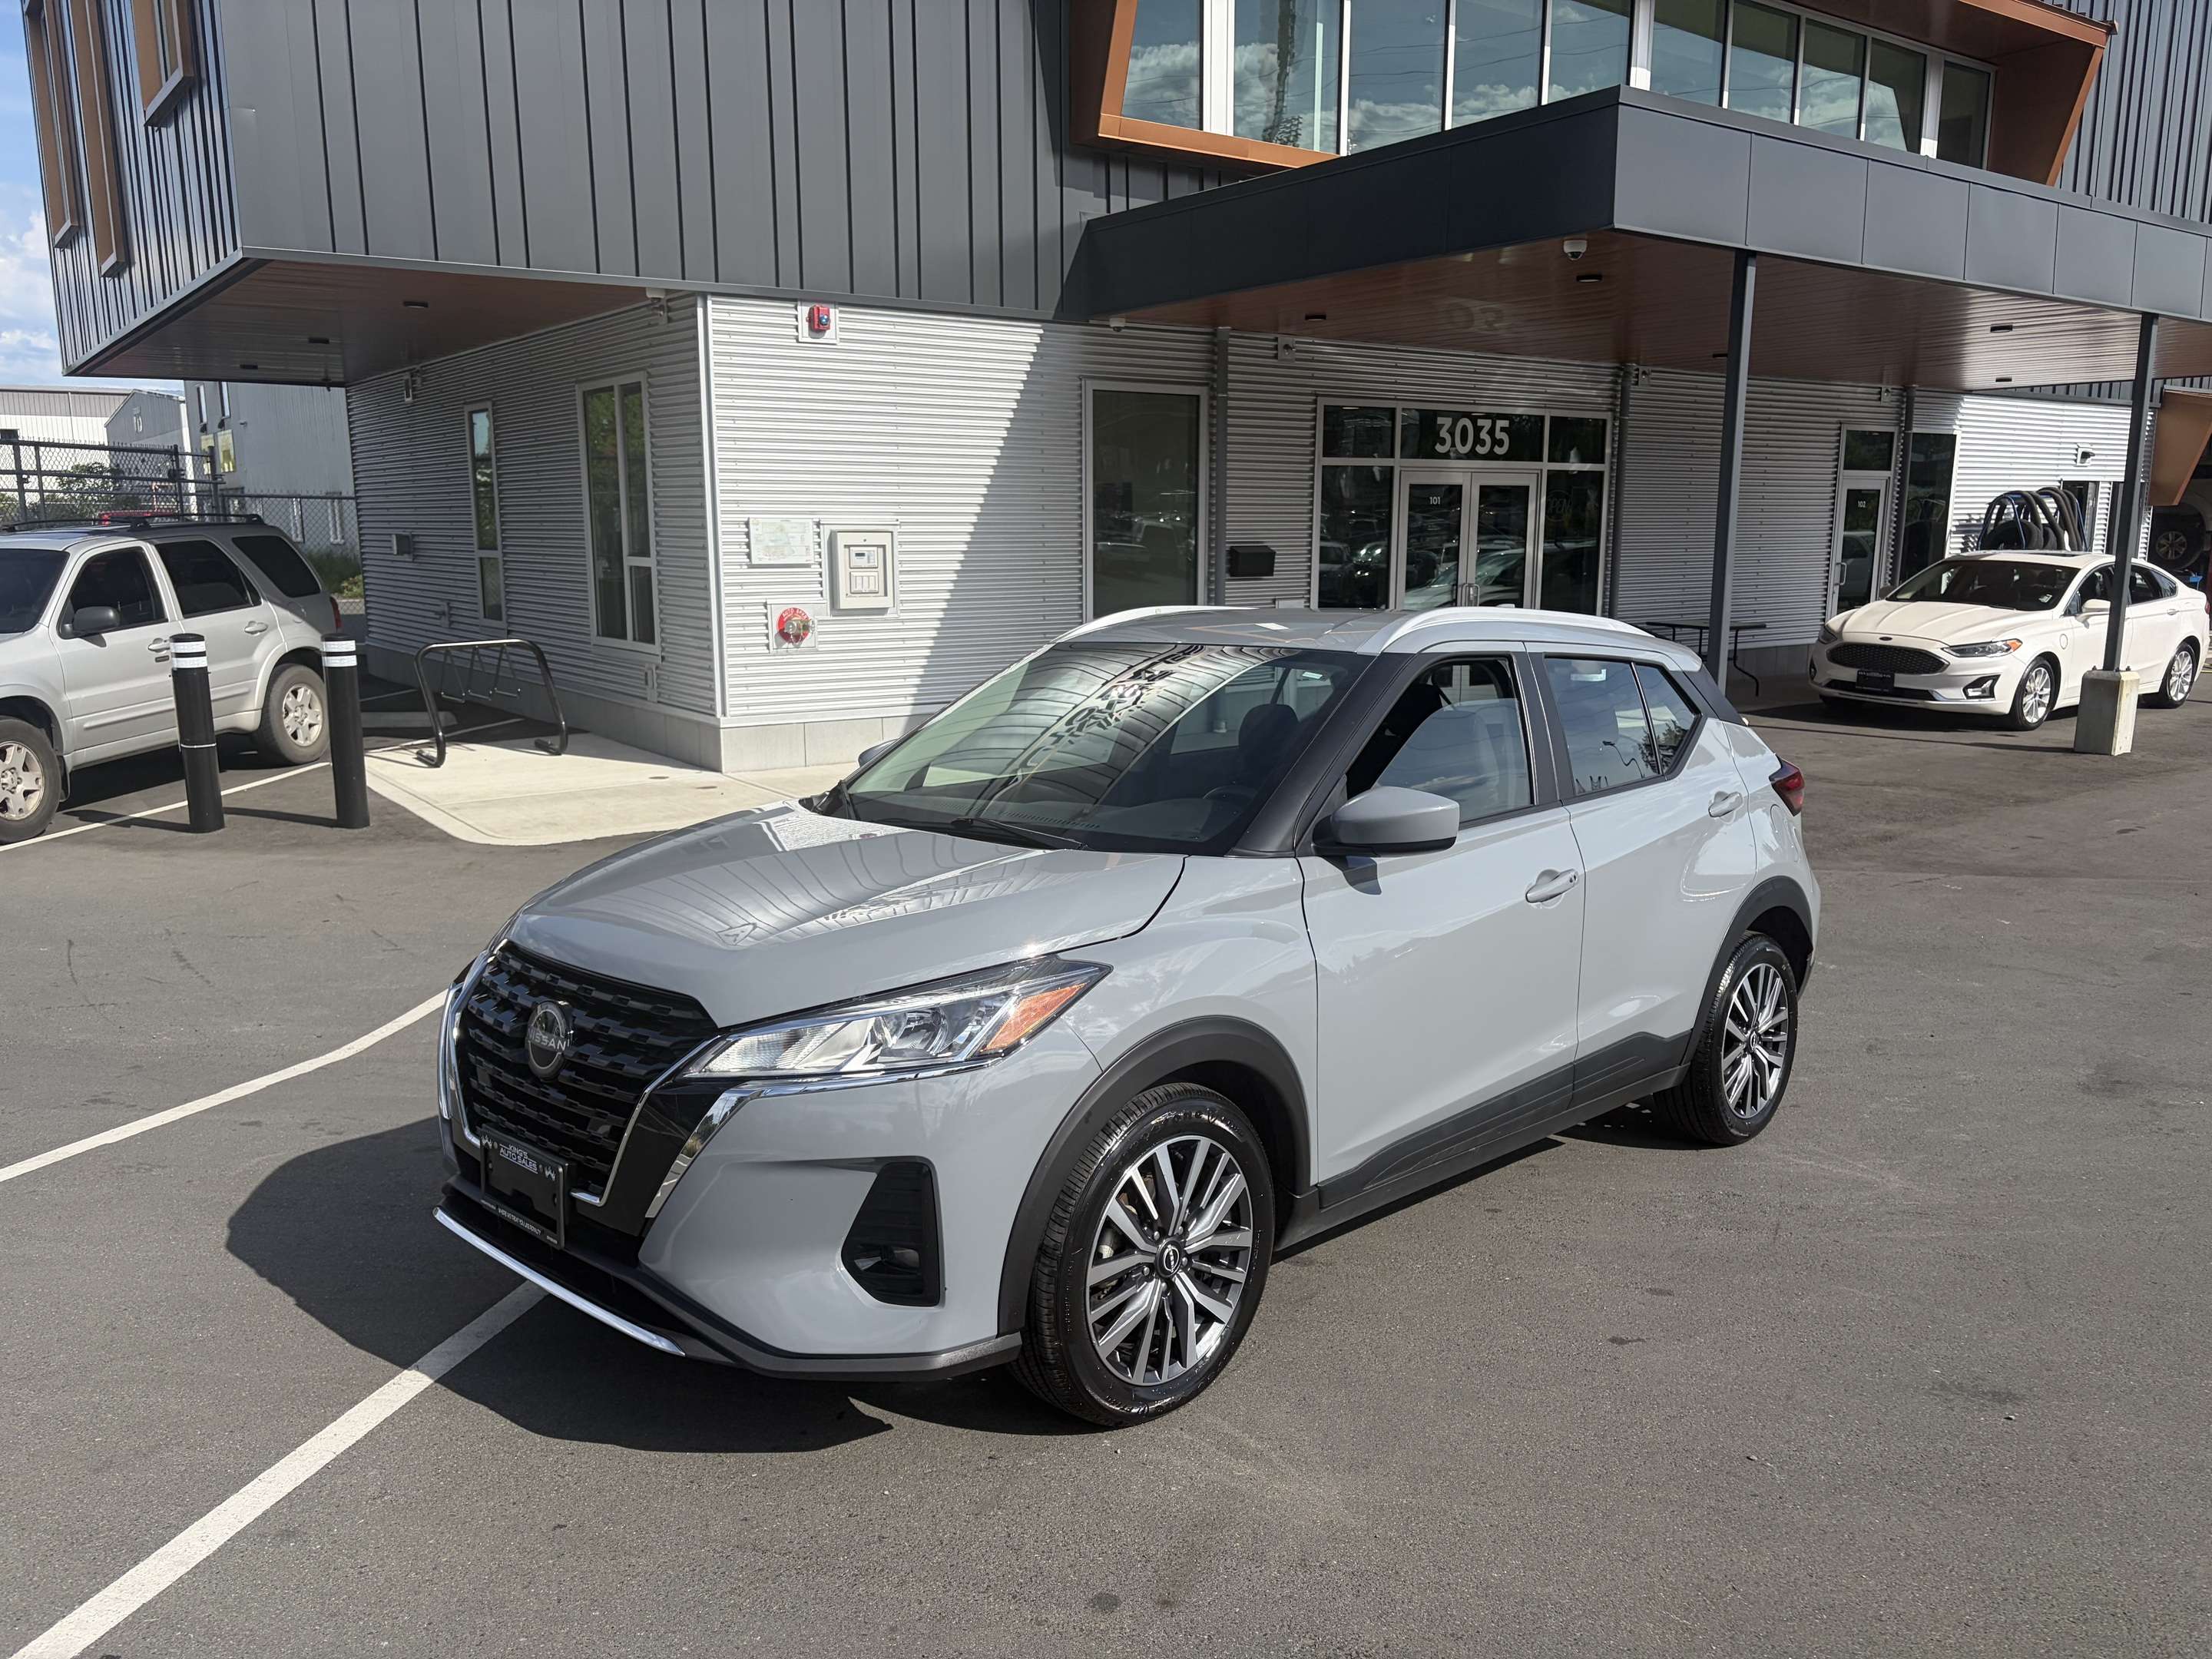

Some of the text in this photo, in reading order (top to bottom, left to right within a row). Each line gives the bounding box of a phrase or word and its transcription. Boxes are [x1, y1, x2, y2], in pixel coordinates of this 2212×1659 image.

[1435, 416, 1510, 455] 3035
[1429, 496, 1441, 505] 101
[528, 1028, 567, 1051] NISSAN
[500, 1147, 538, 1171] AUTO SALES
